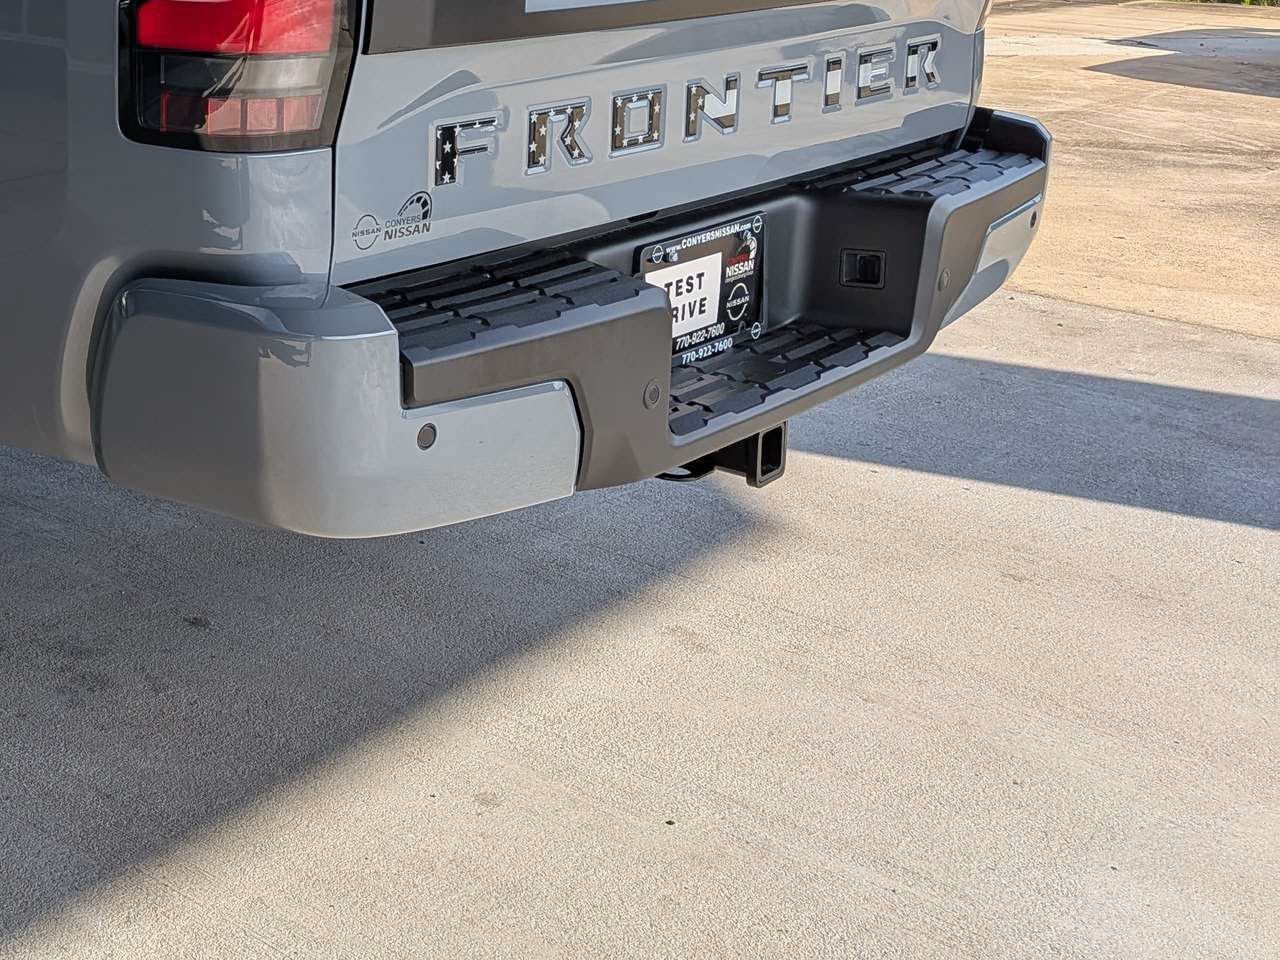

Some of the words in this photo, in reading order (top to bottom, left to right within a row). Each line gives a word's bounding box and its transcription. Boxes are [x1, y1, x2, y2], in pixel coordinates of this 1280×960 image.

[433, 35, 942, 188] FRONTIER
[351, 227, 382, 238] NISSAN
[383, 222, 431, 241] NISSAN
[384, 214, 422, 229] CONYERS
[725, 259, 755, 278] NISSAN
[664, 271, 705, 297] TEST
[672, 296, 708, 323] RIVE
[726, 295, 750, 309] NISSAN
[675, 322, 725, 351] 770-922-7600
[681, 337, 733, 365] 770-922-7600
